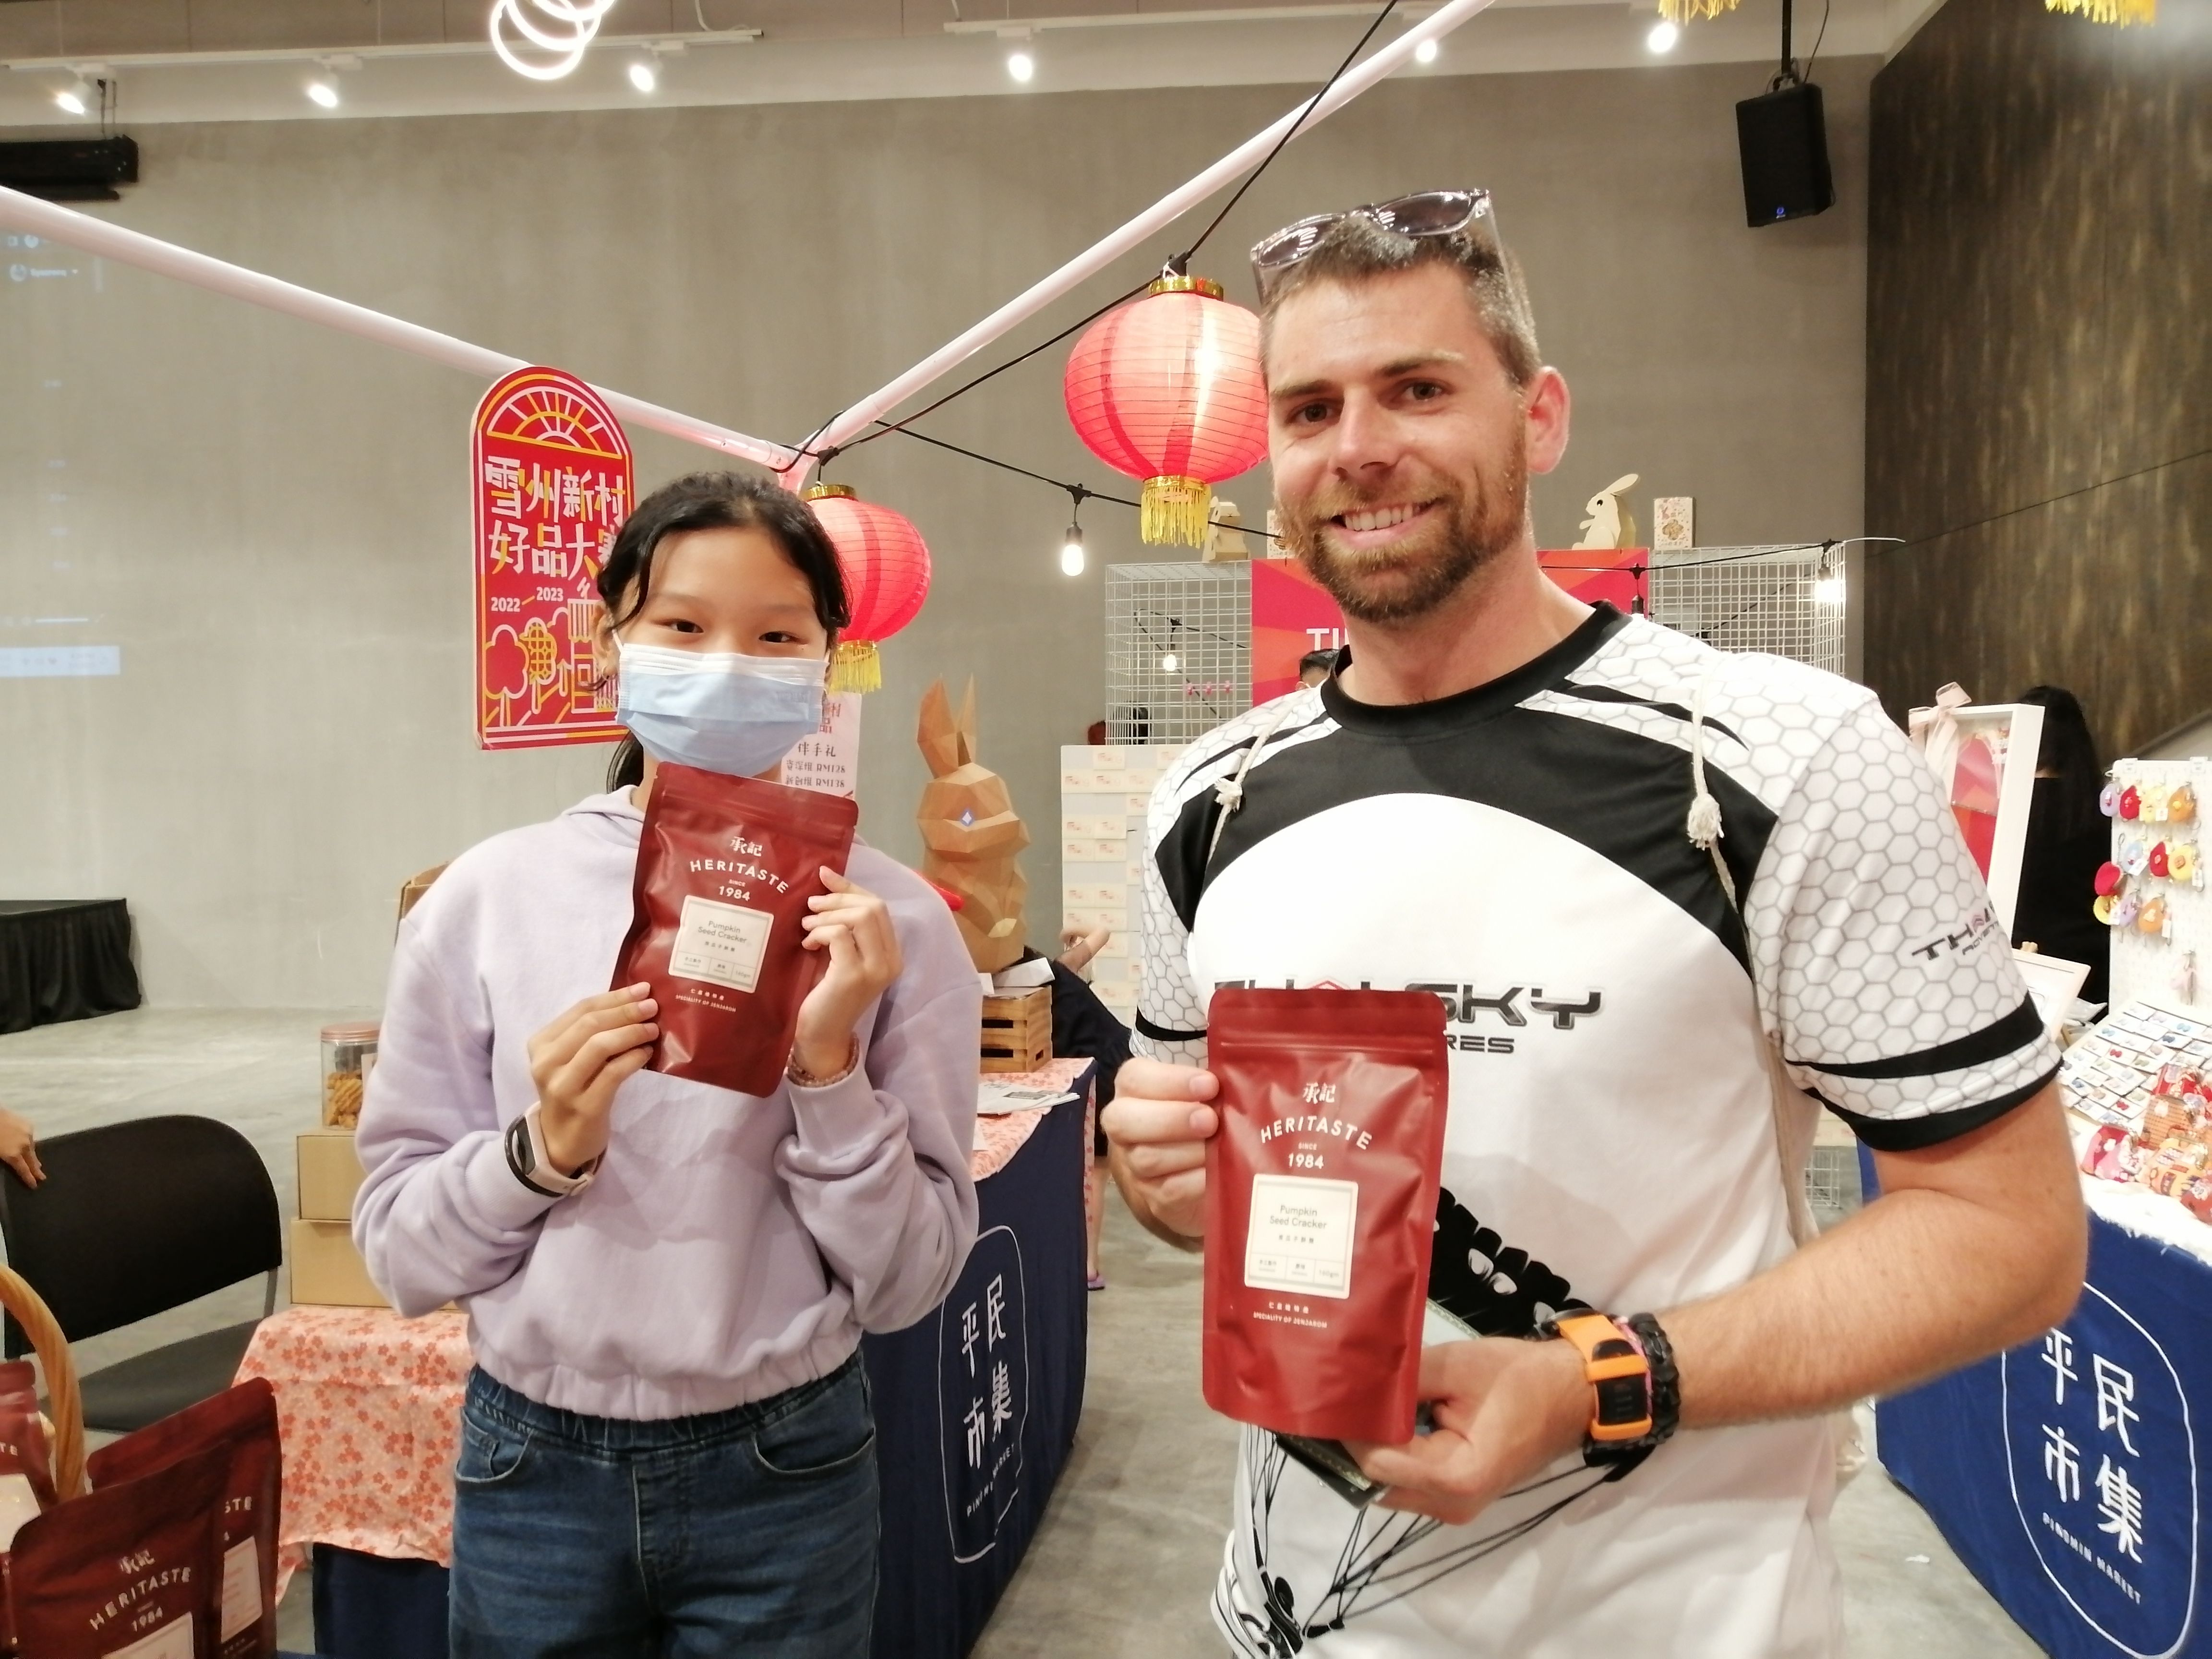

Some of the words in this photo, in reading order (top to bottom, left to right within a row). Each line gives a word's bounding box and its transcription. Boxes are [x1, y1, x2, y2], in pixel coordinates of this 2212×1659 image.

[485, 456, 625, 527] 雪州新村
[491, 597, 520, 612] 2022
[536, 587, 564, 601] 2023
[1306, 628, 1350, 651] TI
[798, 742, 836, 757] 伴手礼
[816, 763, 845, 773] RM128
[816, 778, 844, 788] RM138
[730, 836, 763, 856] 承記
[690, 859, 789, 894] HERITASTE
[729, 879, 745, 887] SINCE
[719, 886, 750, 902] 1984
[698, 926, 716, 936] Seed
[718, 931, 747, 944] Cracker
[709, 920, 741, 933] Pumpkin
[1302, 1082, 1336, 1104] 承記
[1261, 1115, 1373, 1150] HERITASTE
[1298, 1142, 1318, 1151] SINCE
[1288, 1153, 1324, 1169] 1984
[1280, 1204, 1317, 1218] Pumpkin
[1270, 1215, 1289, 1226] Seed
[1292, 1217, 1327, 1229] Cracker
[2042, 1327, 2140, 1457] 平民
[2042, 1423, 2142, 1564] 市集
[89, 1566, 191, 1631] HERITASTE
